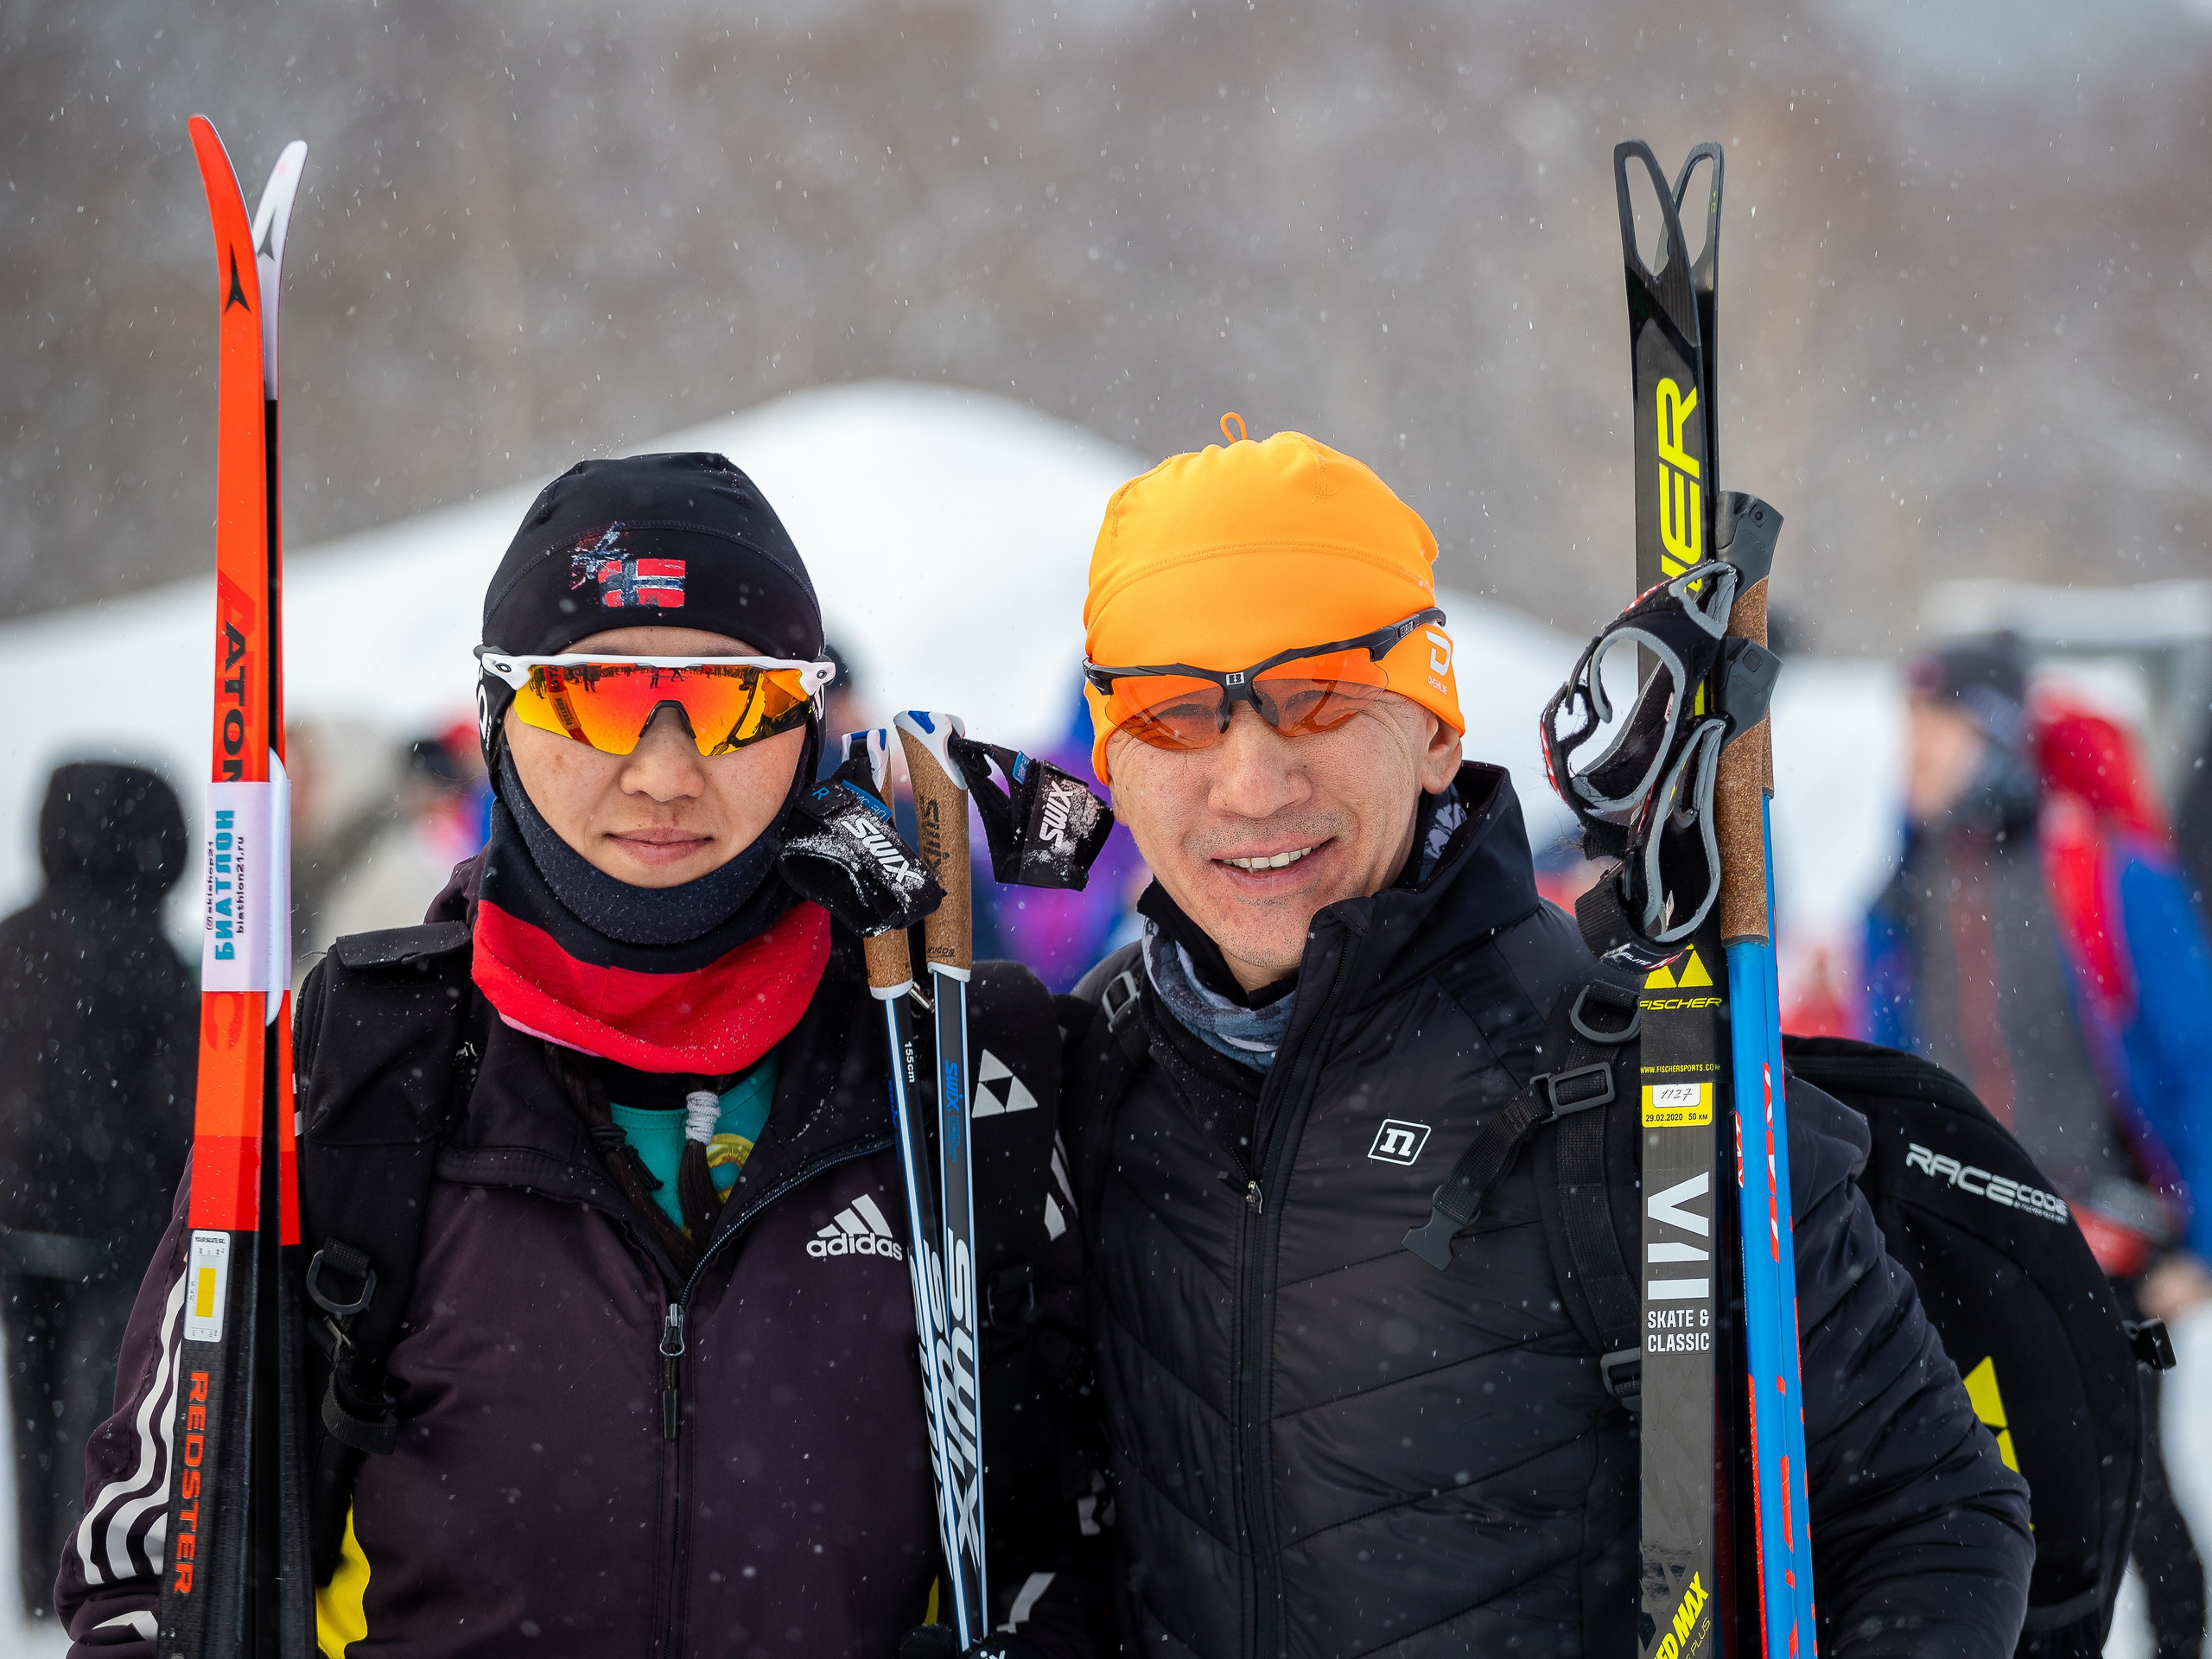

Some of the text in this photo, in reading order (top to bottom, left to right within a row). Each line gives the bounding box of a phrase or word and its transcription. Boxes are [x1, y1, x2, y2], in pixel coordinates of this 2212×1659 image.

[811, 787, 830, 800] R
[214, 810, 235, 960] БИАТЛОН
[236, 836, 245, 934] biathlon21.ru
[1639, 997, 1722, 1010] FISCHER
[905, 1041, 914, 1083] 155cm
[1661, 1088, 1694, 1102] 1127
[1645, 1113, 1683, 1122] 29.02.2020
[1688, 1112, 1697, 1121] 50
[806, 1233, 903, 1261] adidas
[1648, 1309, 1710, 1329] SKATE &
[1648, 1332, 1710, 1353] CLASSIC
[174, 1371, 209, 1595] REDSTER
[1672, 1571, 1709, 1648] MAX
[1691, 1617, 1711, 1655] PLUS
